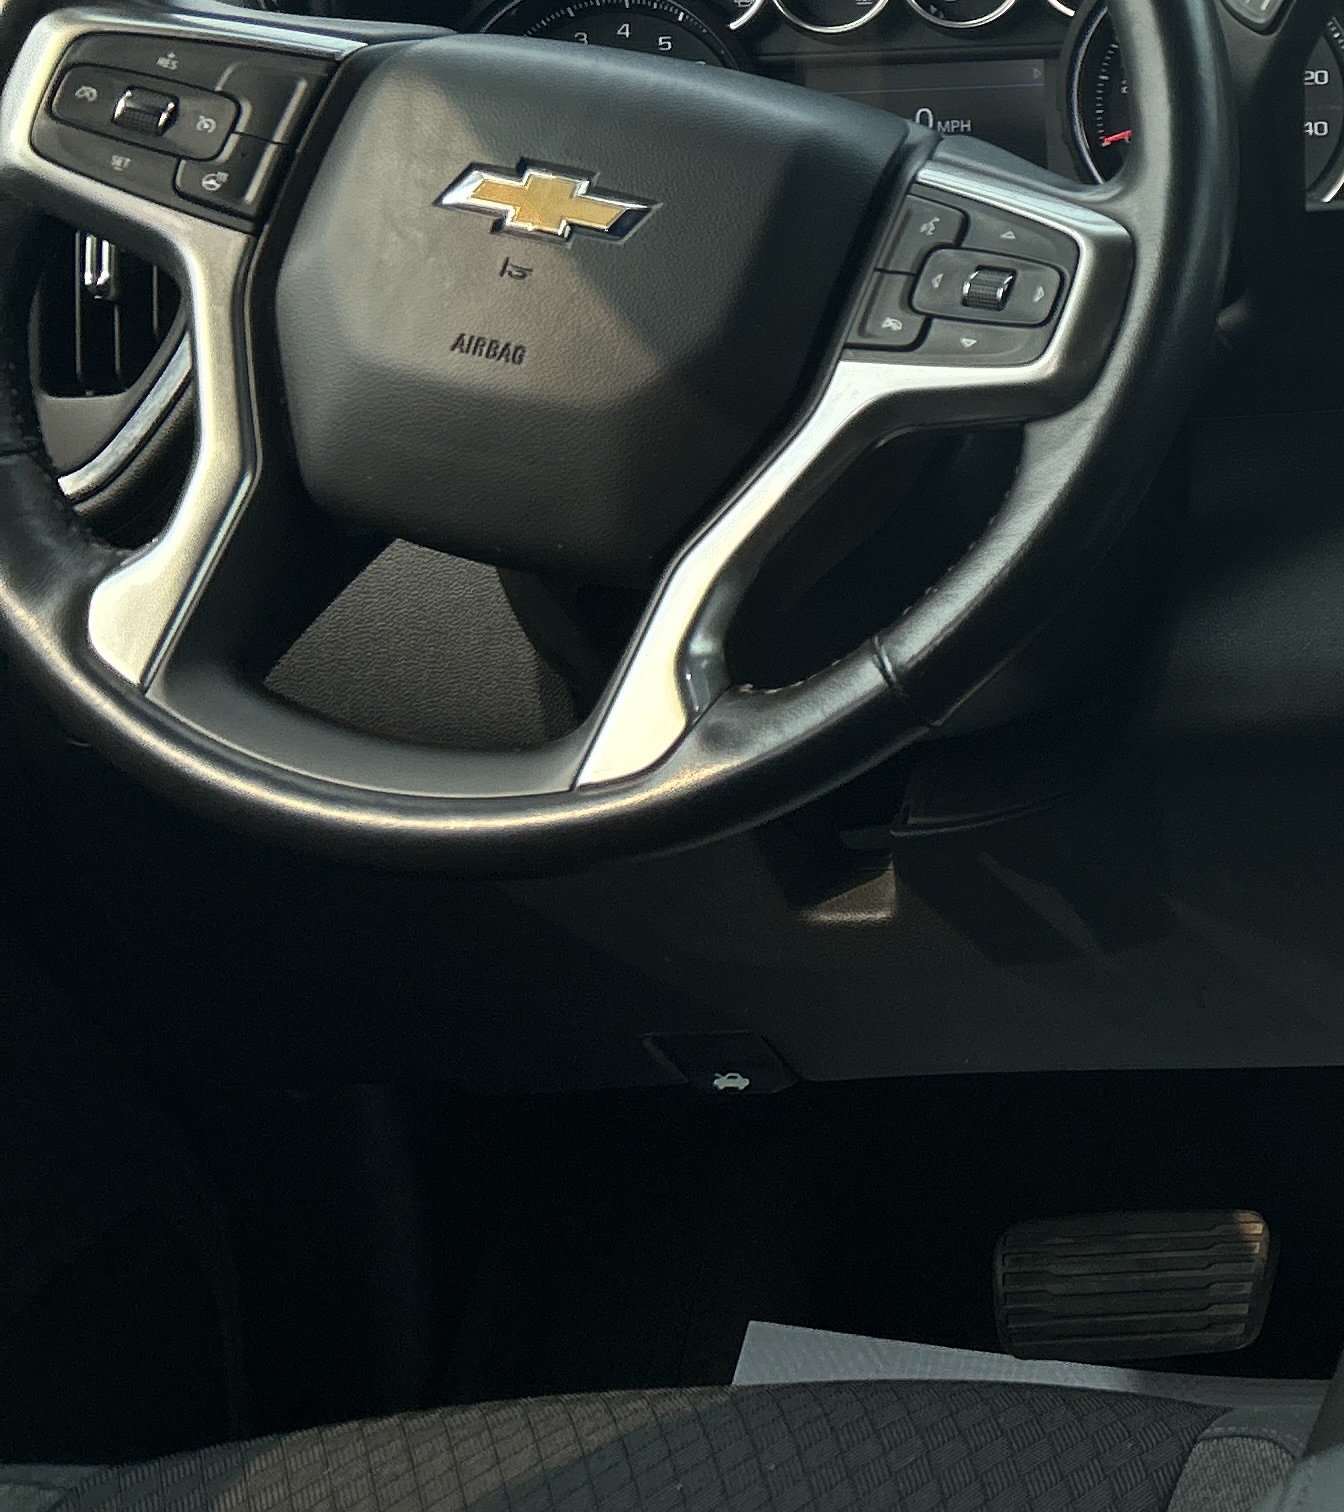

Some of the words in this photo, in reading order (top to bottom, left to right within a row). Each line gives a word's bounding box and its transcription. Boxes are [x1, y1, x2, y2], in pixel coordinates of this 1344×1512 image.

[616, 23, 631, 38] 4
[658, 36, 673, 51] 5
[937, 119, 972, 134] MPH
[450, 333, 528, 366] AIRBAG
